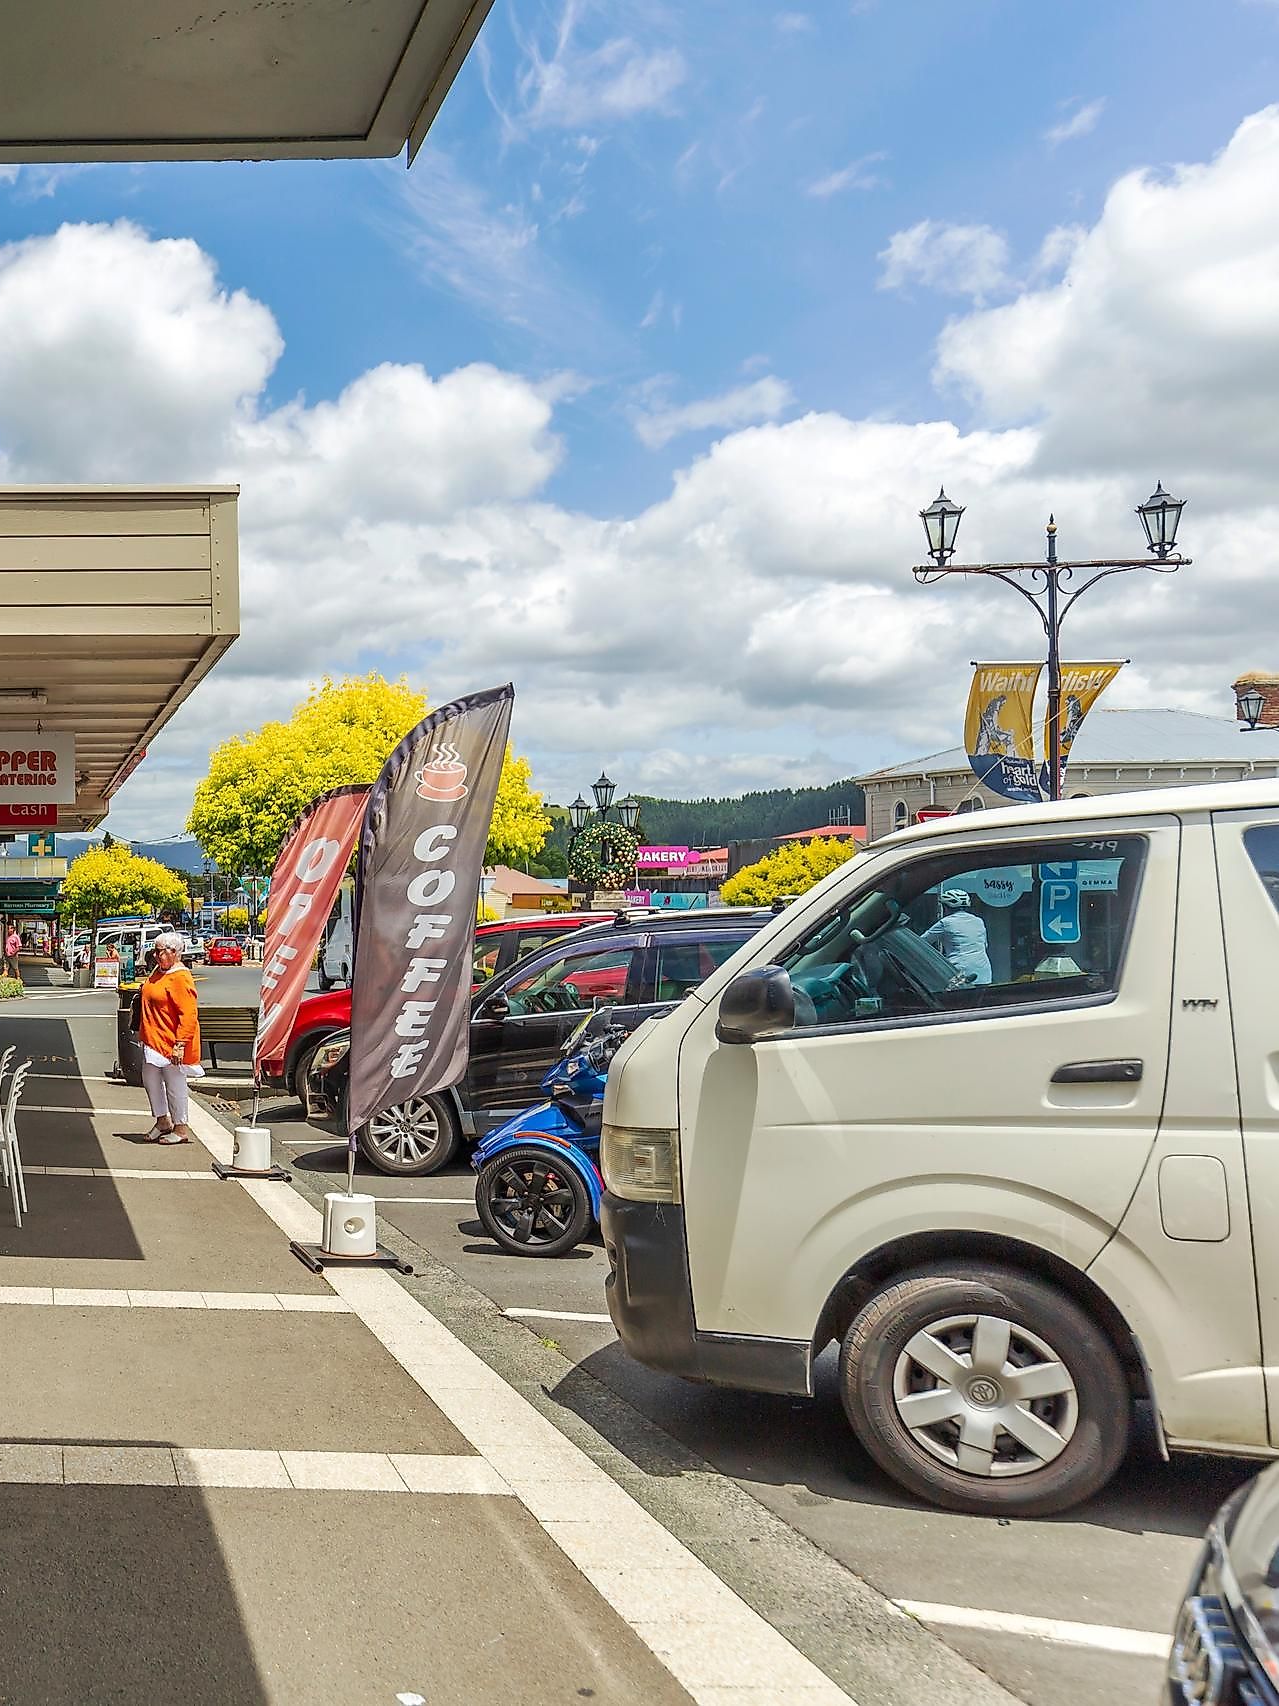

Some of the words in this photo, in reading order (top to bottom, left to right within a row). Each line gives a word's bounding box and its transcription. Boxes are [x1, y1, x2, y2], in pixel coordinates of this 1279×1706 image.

[1001, 762, 1031, 776] heart
[1013, 773, 1038, 786] gold
[9, 804, 48, 816] Cash
[983, 878, 1015, 892] sassy
[1049, 885, 1071, 910] P
[390, 824, 458, 1079] COFFEE
